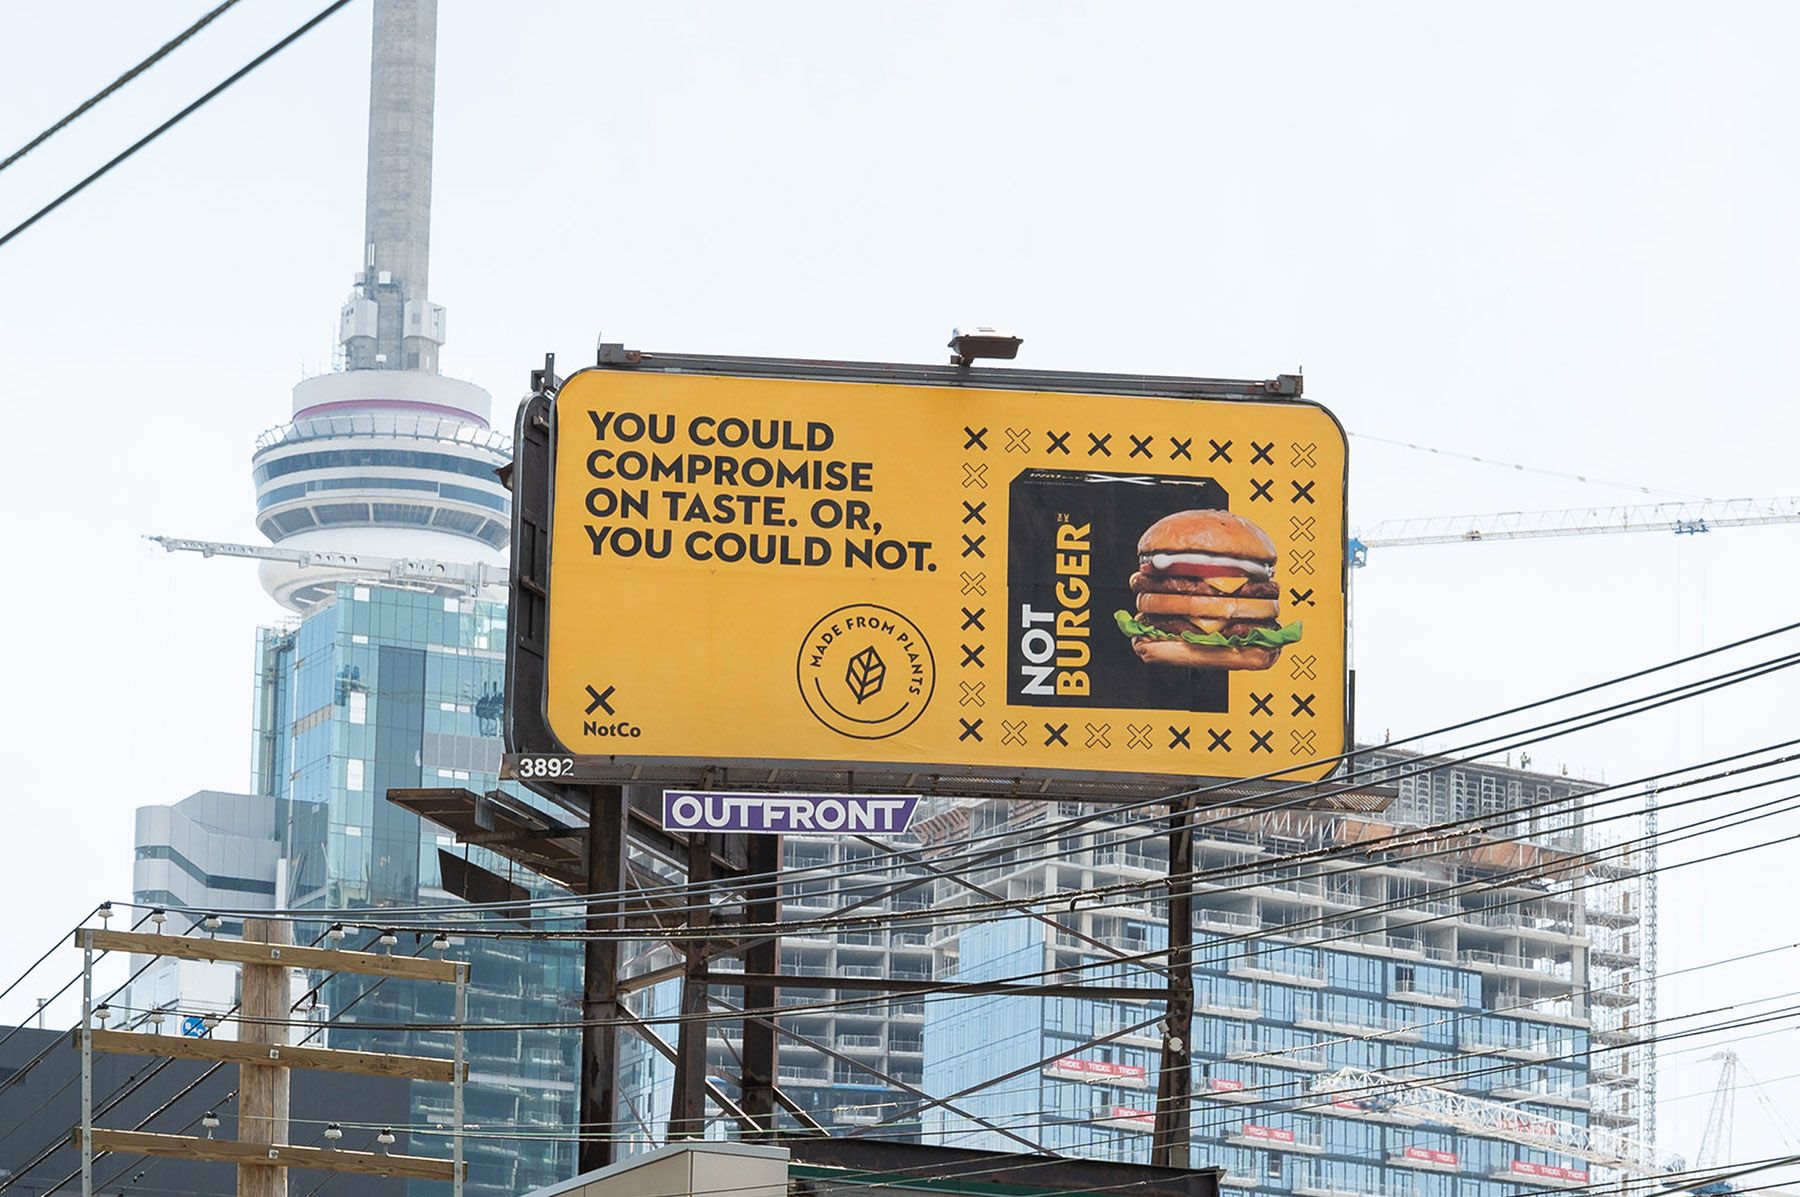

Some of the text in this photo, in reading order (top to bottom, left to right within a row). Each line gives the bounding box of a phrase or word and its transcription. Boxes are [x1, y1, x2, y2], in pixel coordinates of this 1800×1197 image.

[586, 410, 835, 452] YOU COULD
[586, 448, 874, 493] COMPROMISE
[585, 487, 883, 536] ON TASTE. OR,
[584, 525, 938, 573] YOU COULD NOT.
[1056, 523, 1091, 696] BURGER
[809, 616, 924, 696] MADE FROM PLANTS
[1021, 603, 1055, 696] NOT
[583, 720, 642, 738] NotCo
[520, 757, 575, 778] 3892
[671, 795, 906, 830] OUTFRONT
